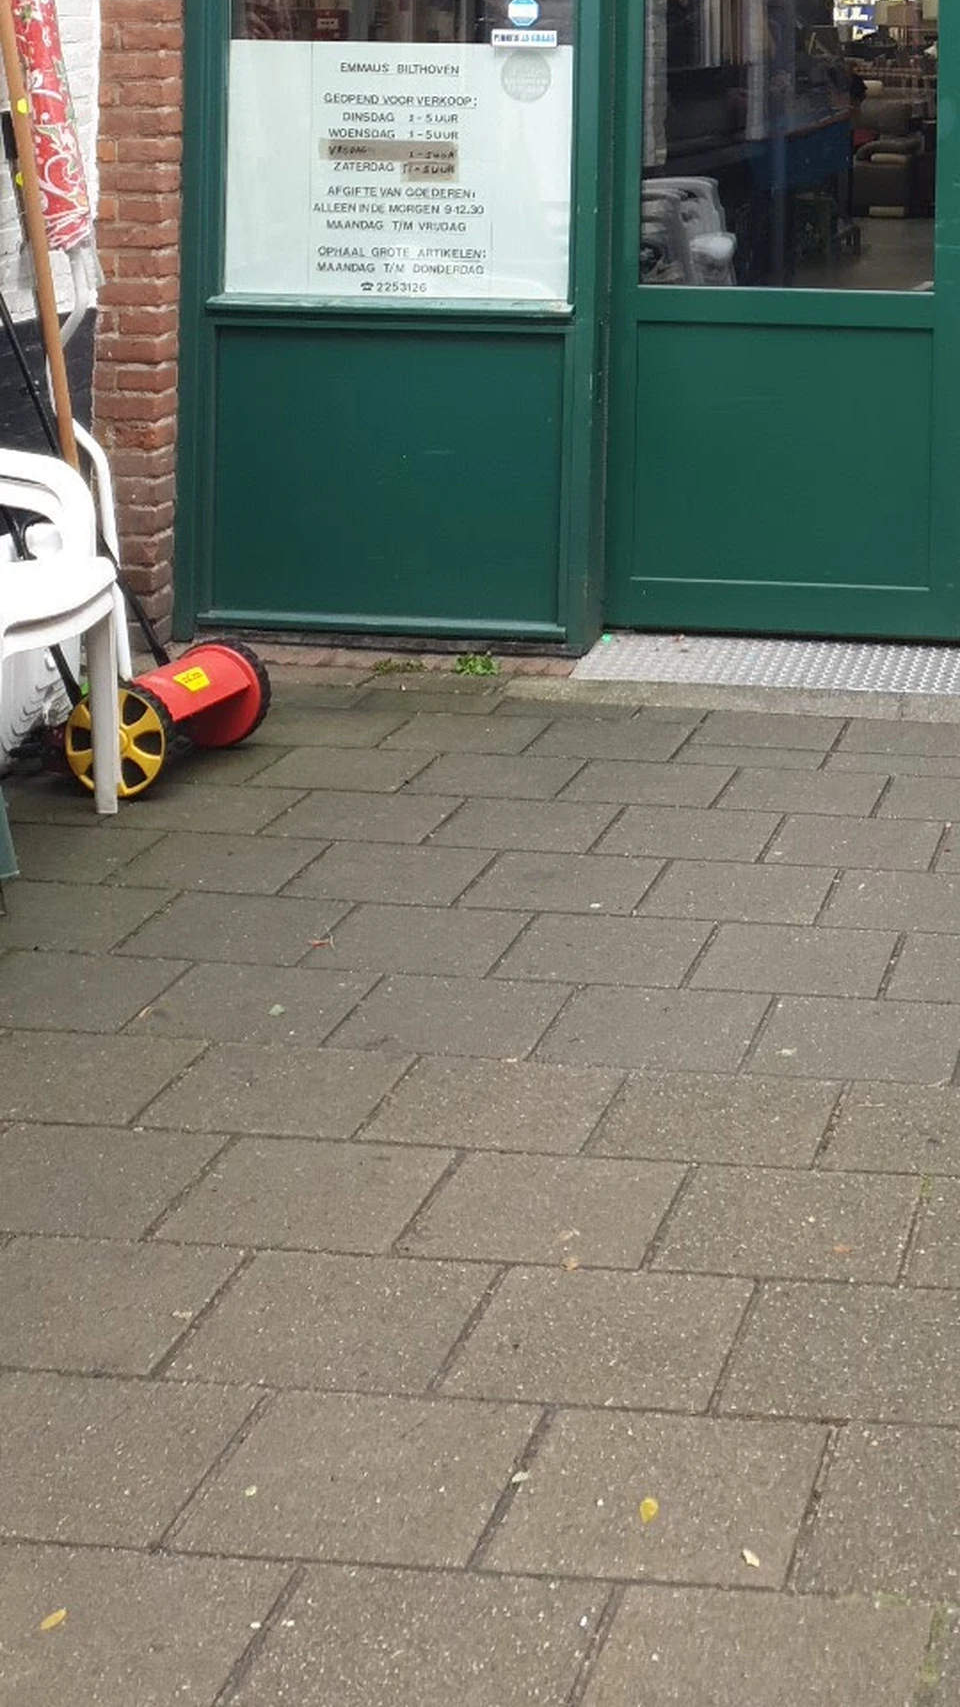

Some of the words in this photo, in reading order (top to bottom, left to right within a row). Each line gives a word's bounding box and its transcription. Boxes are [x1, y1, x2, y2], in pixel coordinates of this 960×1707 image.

[340, 62, 389, 73] EMMAUS
[397, 63, 460, 75] BILTHOVEN
[323, 93, 379, 105] GEOPEND
[383, 95, 415, 106] VOOR
[417, 96, 478, 107] VERKOOP:
[342, 112, 395, 123] DINSDAG
[328, 128, 395, 140] WOENSDAG
[333, 162, 395, 173] ZATERDAG
[327, 186, 377, 197] AFGIFTE
[380, 187, 400, 197] VAN
[313, 202, 357, 213] ALLEEN
[389, 204, 440, 215] MORGEN
[326, 220, 384, 231] MAANDAG
[392, 220, 413, 232] T/M
[317, 246, 365, 257] OPHAAL
[371, 247, 410, 258] GROTE
[417, 248, 486, 260] ARTIKELEN:
[316, 262, 375, 274] MAANDAG
[383, 263, 404, 274] T/M
[413, 264, 485, 275] DONDERDAG
